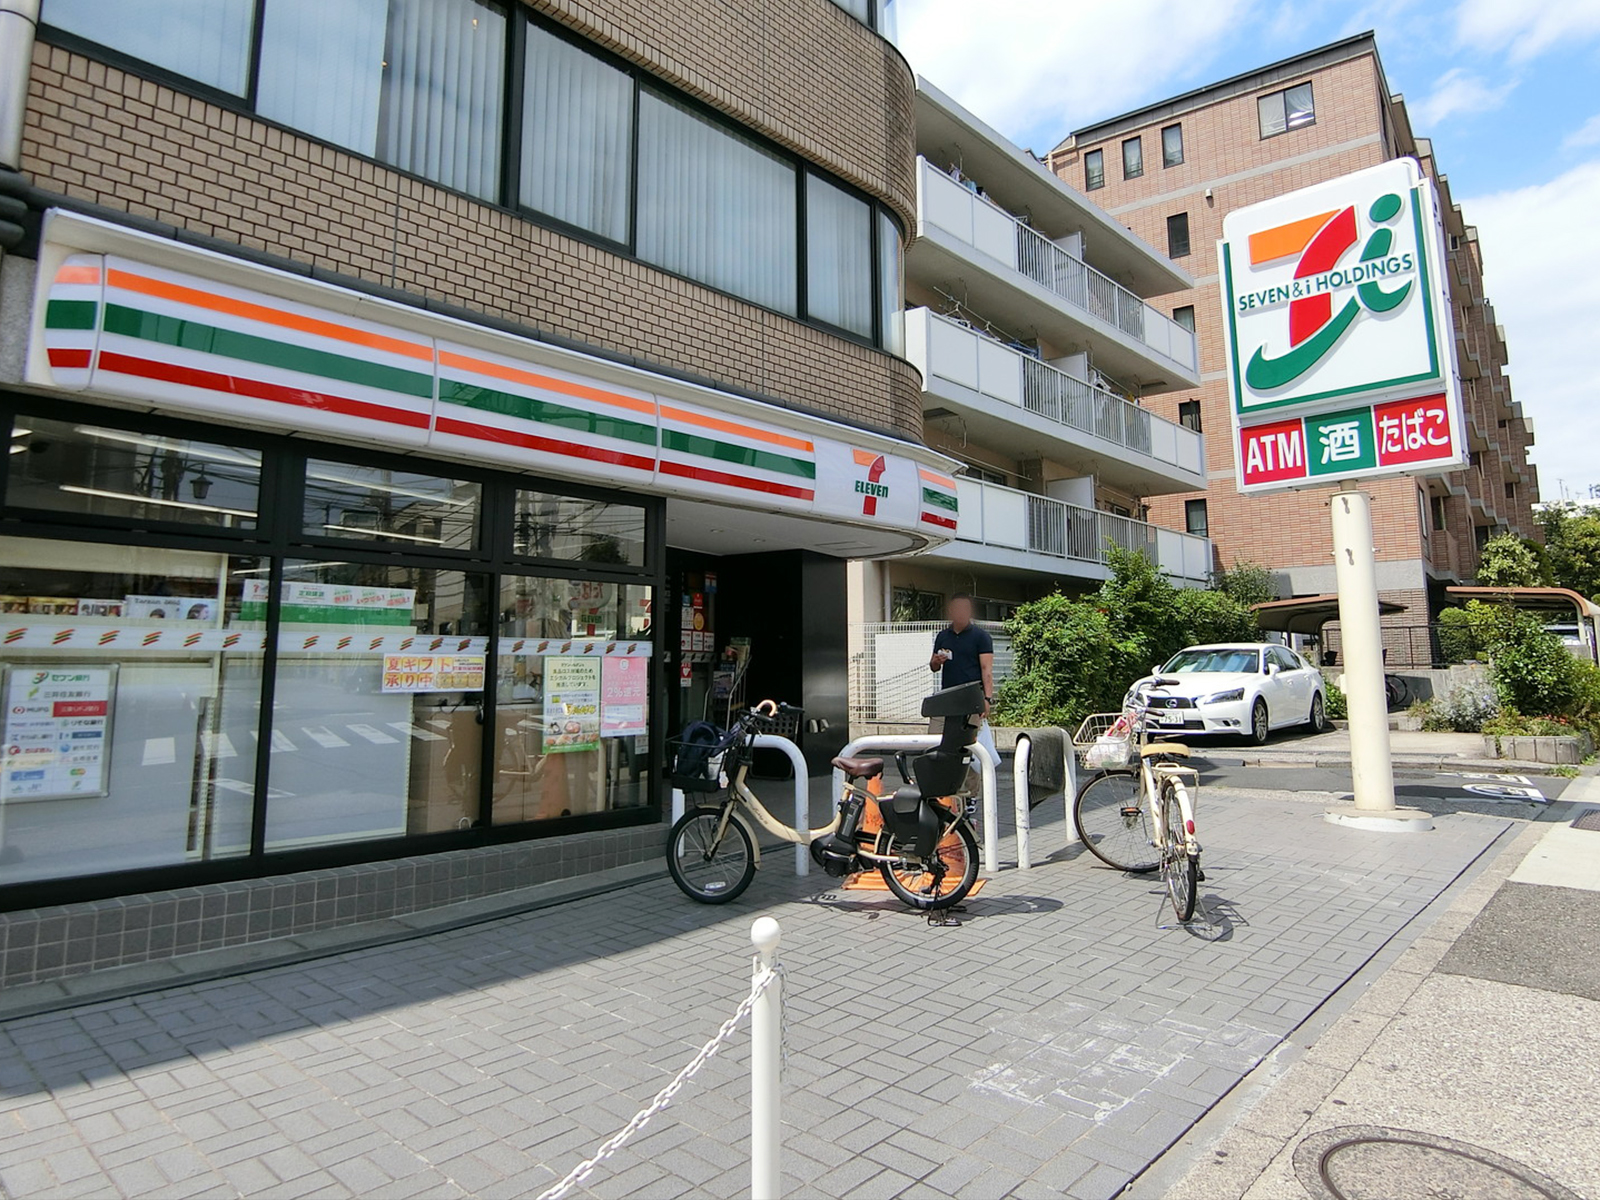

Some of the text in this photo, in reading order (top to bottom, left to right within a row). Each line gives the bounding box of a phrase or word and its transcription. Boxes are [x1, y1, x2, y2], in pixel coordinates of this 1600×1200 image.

[1316, 254, 1413, 291] HOLDINGS
[1317, 419, 1361, 466] 酒
[1378, 407, 1450, 456] たばこ
[1246, 430, 1303, 475] ATM
[855, 480, 889, 498] ELEVEN
[387, 657, 450, 672] 夏ギフト
[385, 673, 432, 688] 承り中
[606, 686, 642, 698] 2%還元
